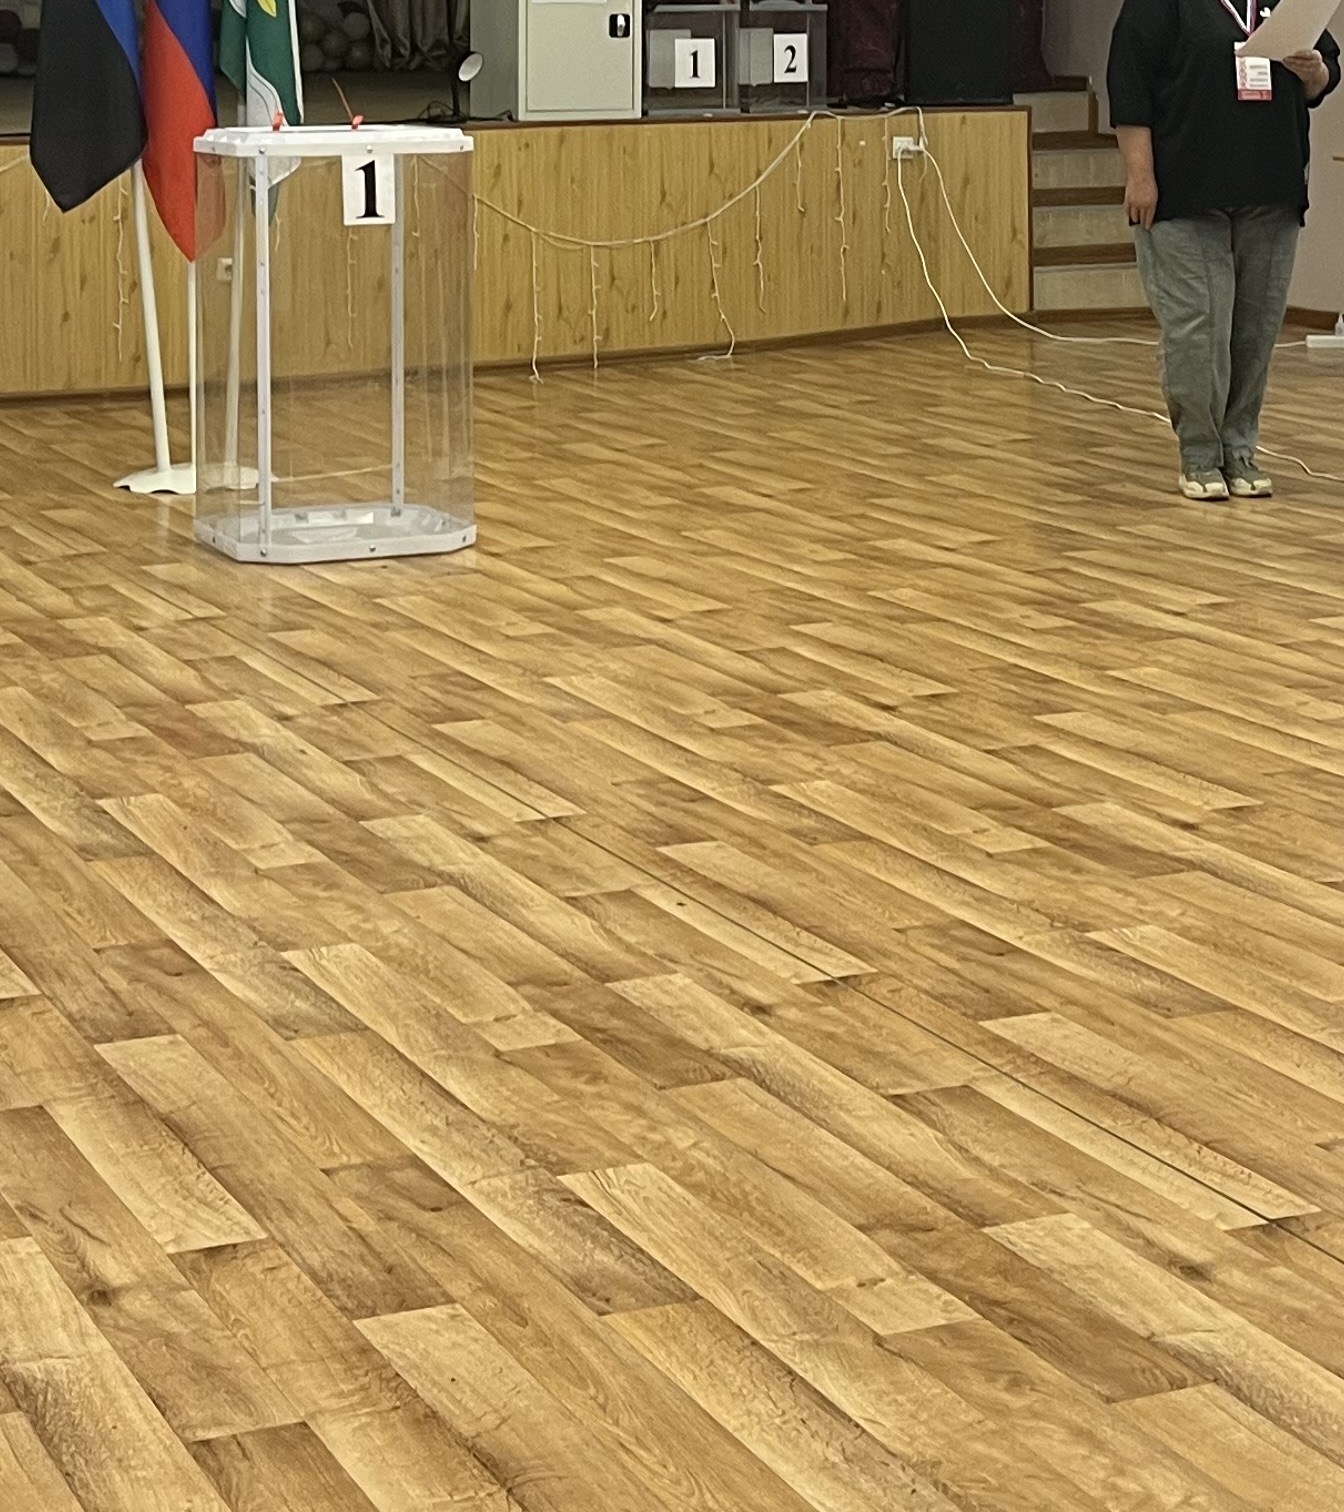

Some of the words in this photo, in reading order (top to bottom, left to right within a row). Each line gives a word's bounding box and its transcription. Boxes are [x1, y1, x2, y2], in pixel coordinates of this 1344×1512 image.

[690, 49, 700, 79] 1
[783, 44, 797, 74] 2
[355, 159, 384, 219] 1
